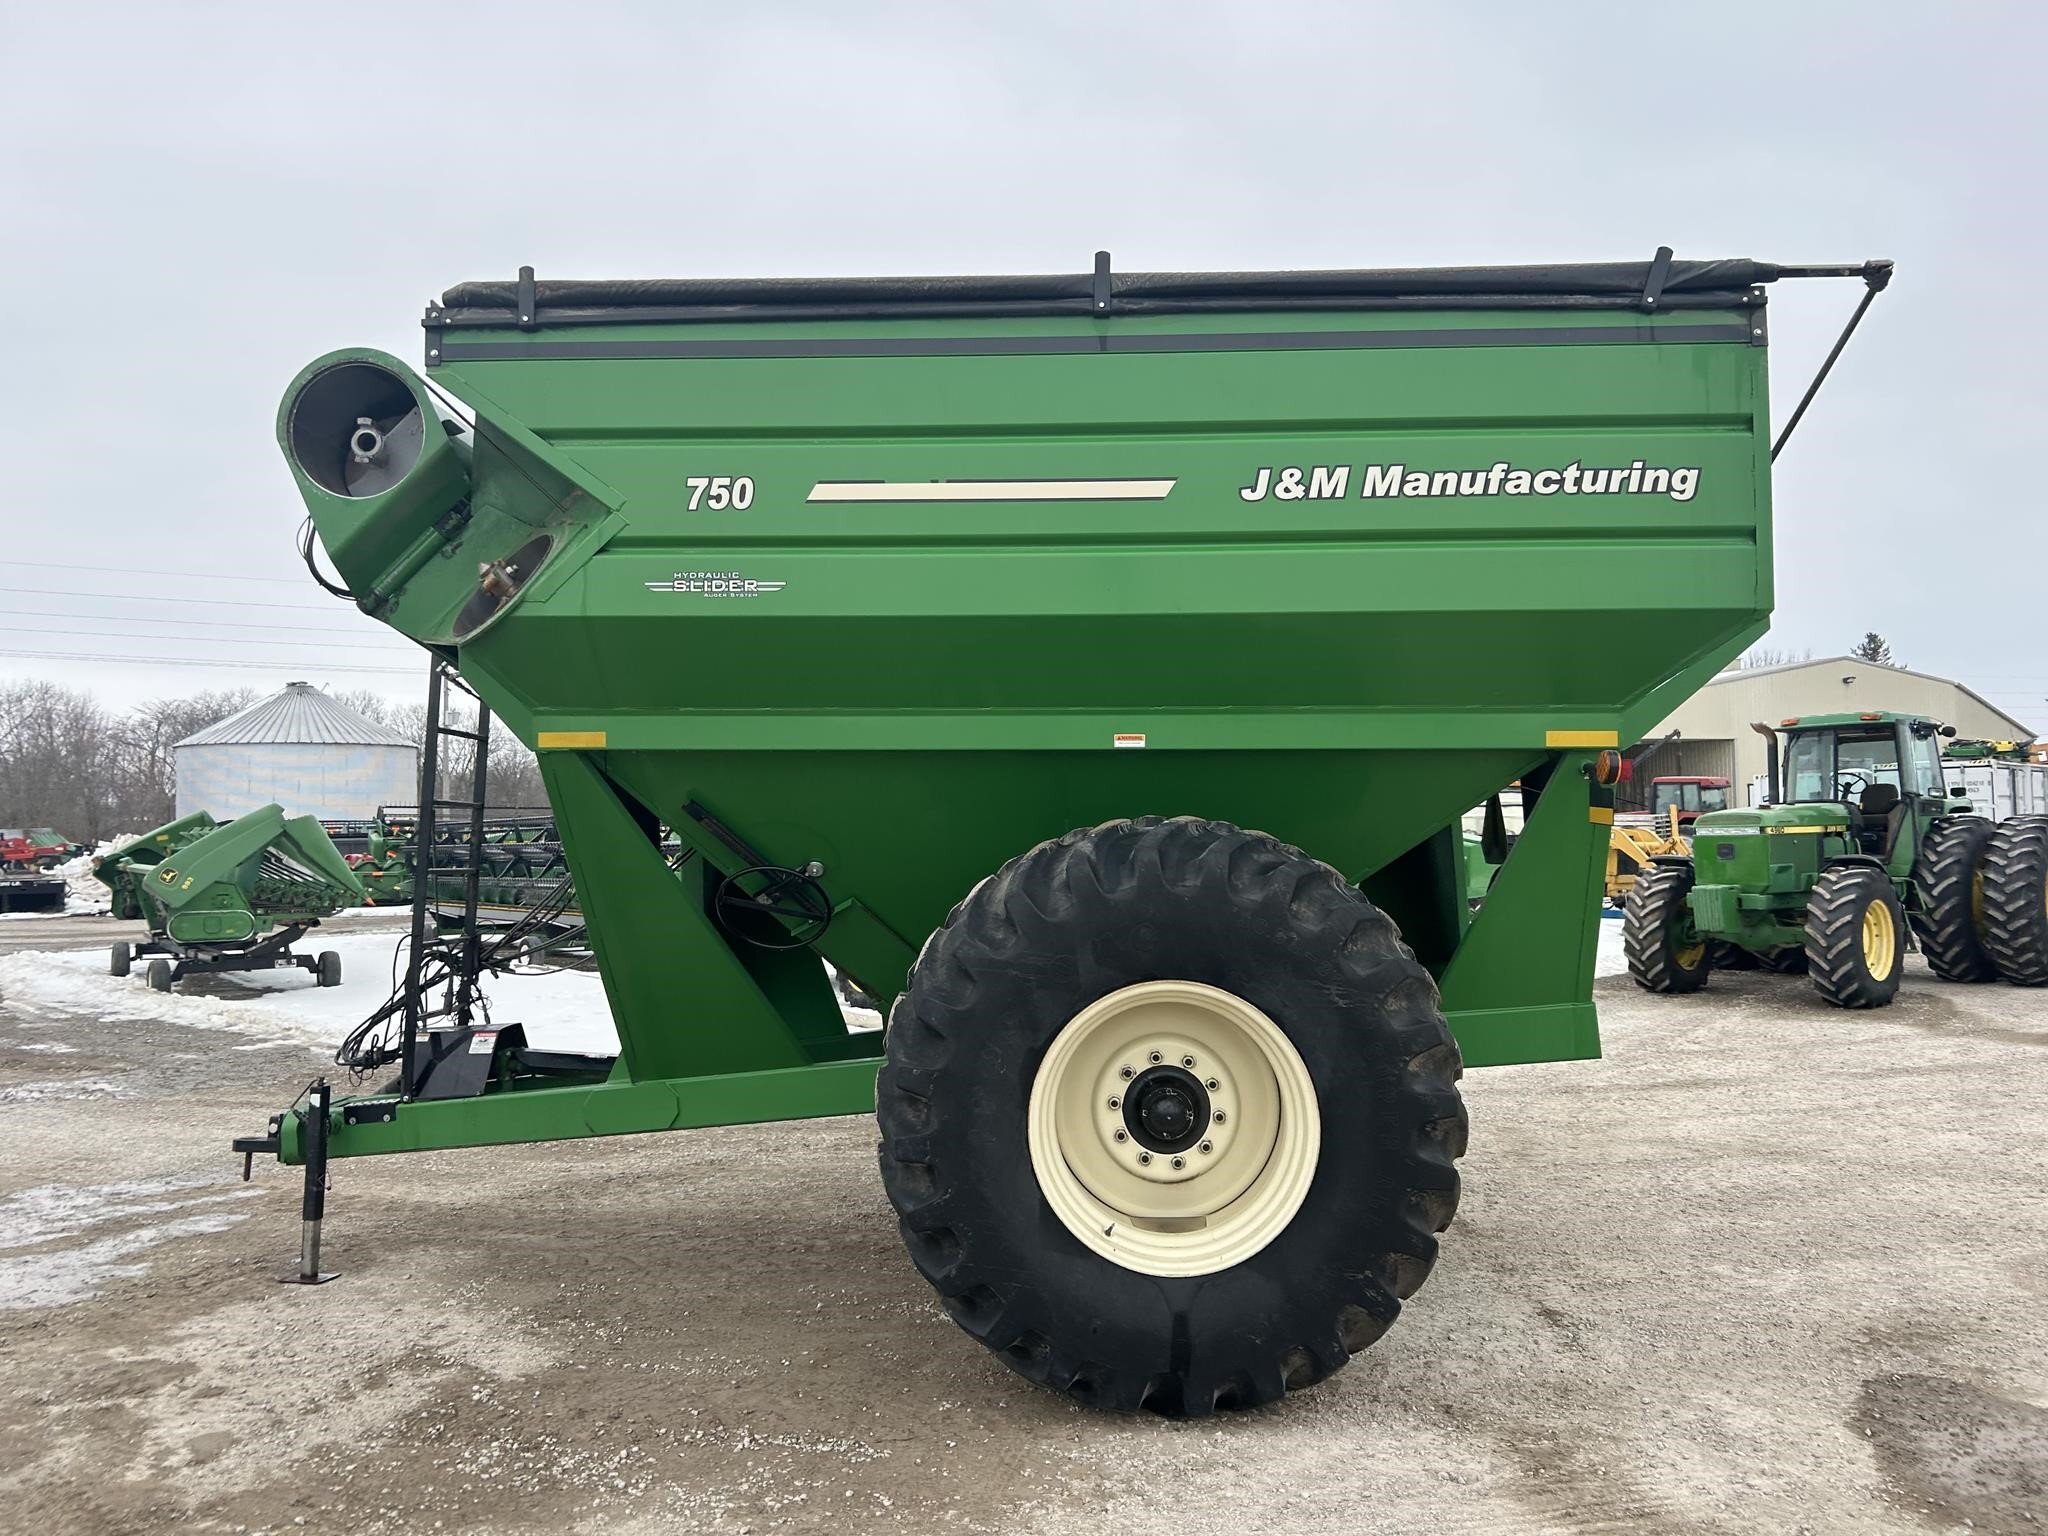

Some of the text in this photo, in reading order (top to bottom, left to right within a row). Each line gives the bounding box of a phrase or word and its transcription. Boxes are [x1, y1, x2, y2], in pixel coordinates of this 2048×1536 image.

[686, 476, 755, 511] 750
[1239, 460, 1702, 502] J&M Manufacturing
[673, 580, 758, 592] SLIDER
